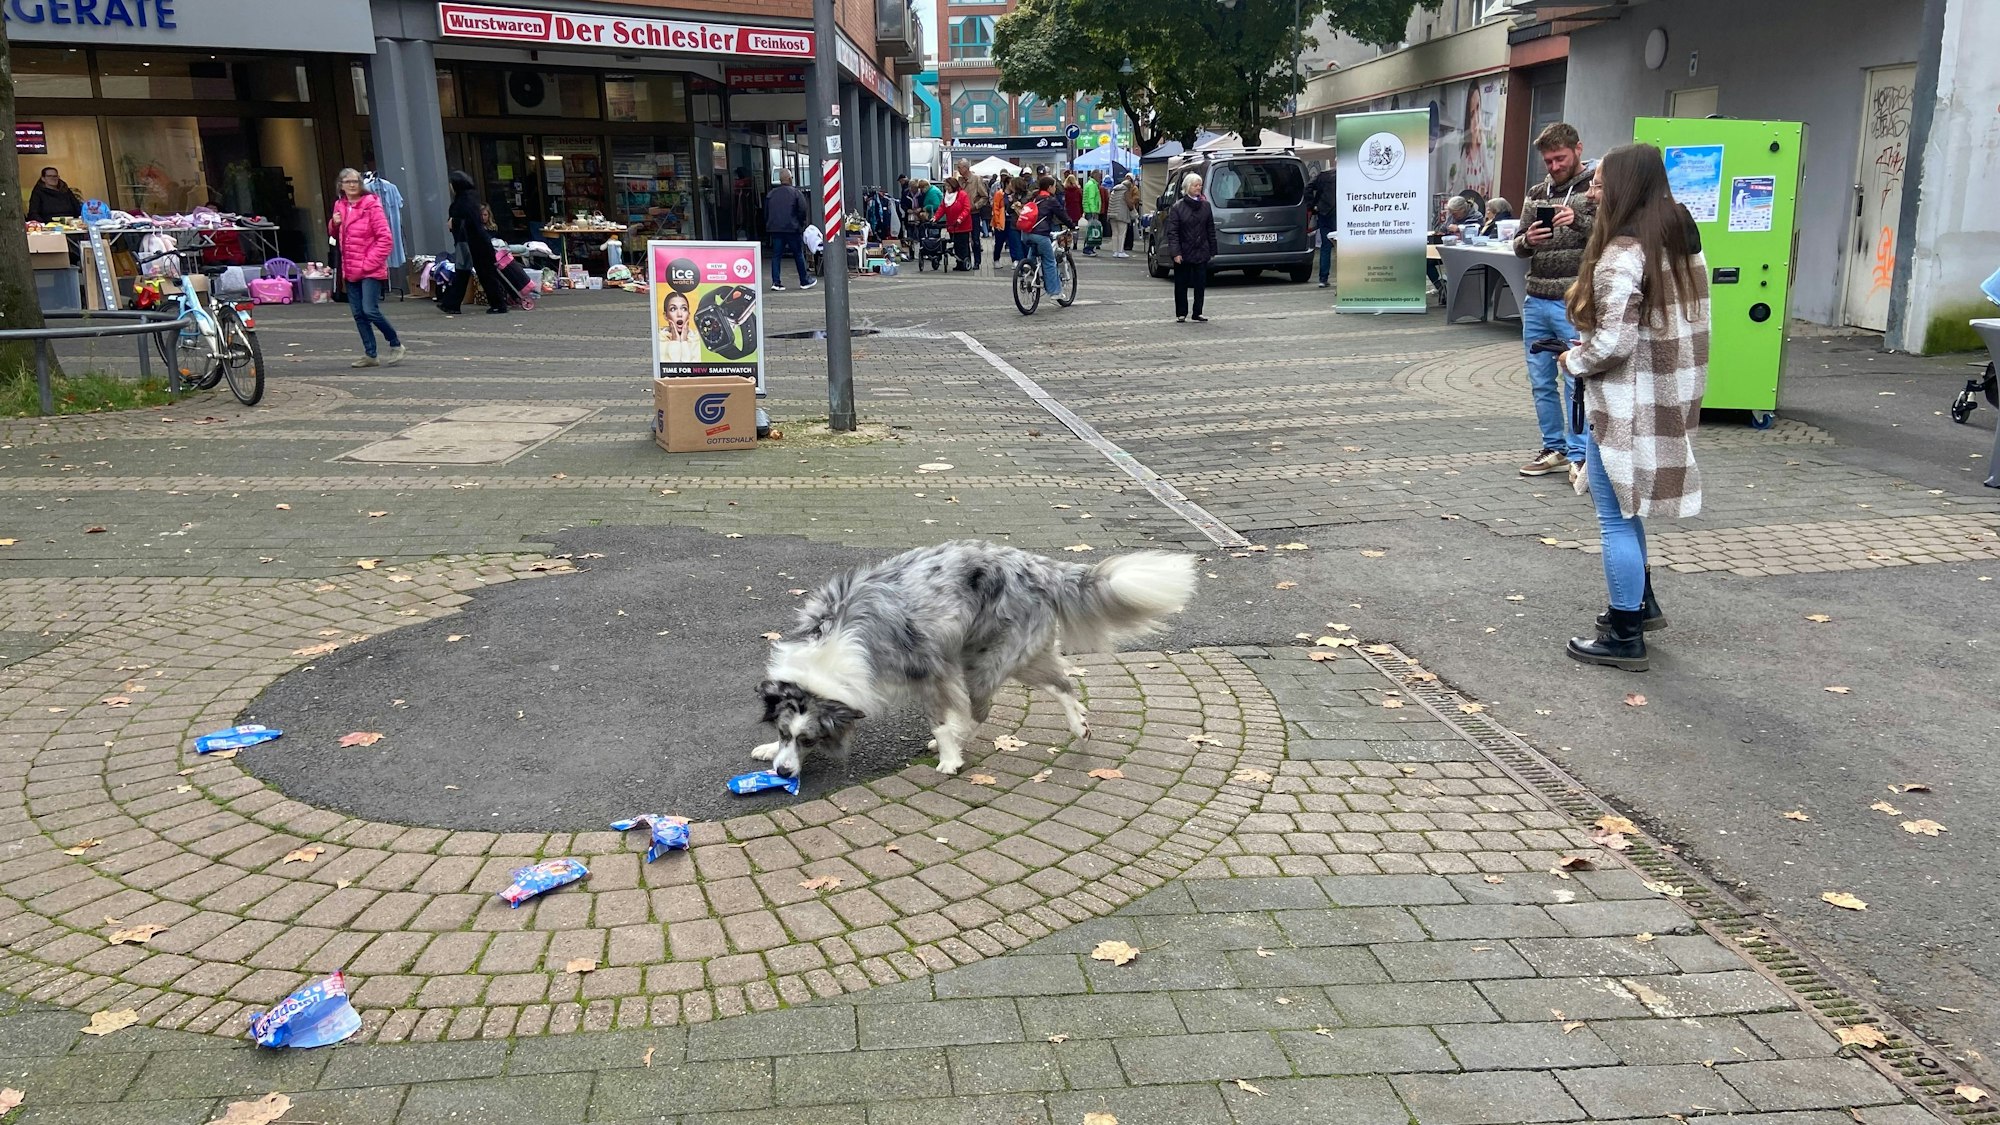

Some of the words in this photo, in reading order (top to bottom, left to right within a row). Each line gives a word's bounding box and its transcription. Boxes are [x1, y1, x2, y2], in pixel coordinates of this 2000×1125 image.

[449, 14, 543, 33] Wurstwaren
[555, 17, 605, 42] Der
[613, 21, 734, 51] Schlesier
[754, 36, 805, 51] Feinkost
[730, 74, 784, 85] PREET
[1346, 190, 1417, 201] Tierschutzverein
[1352, 203, 1392, 212] Köln-Porz
[1394, 202, 1410, 211] e.V.
[1349, 228, 1366, 236] Tiere
[672, 266, 695, 279] ice
[706, 436, 755, 446] GOTTSCHALK
